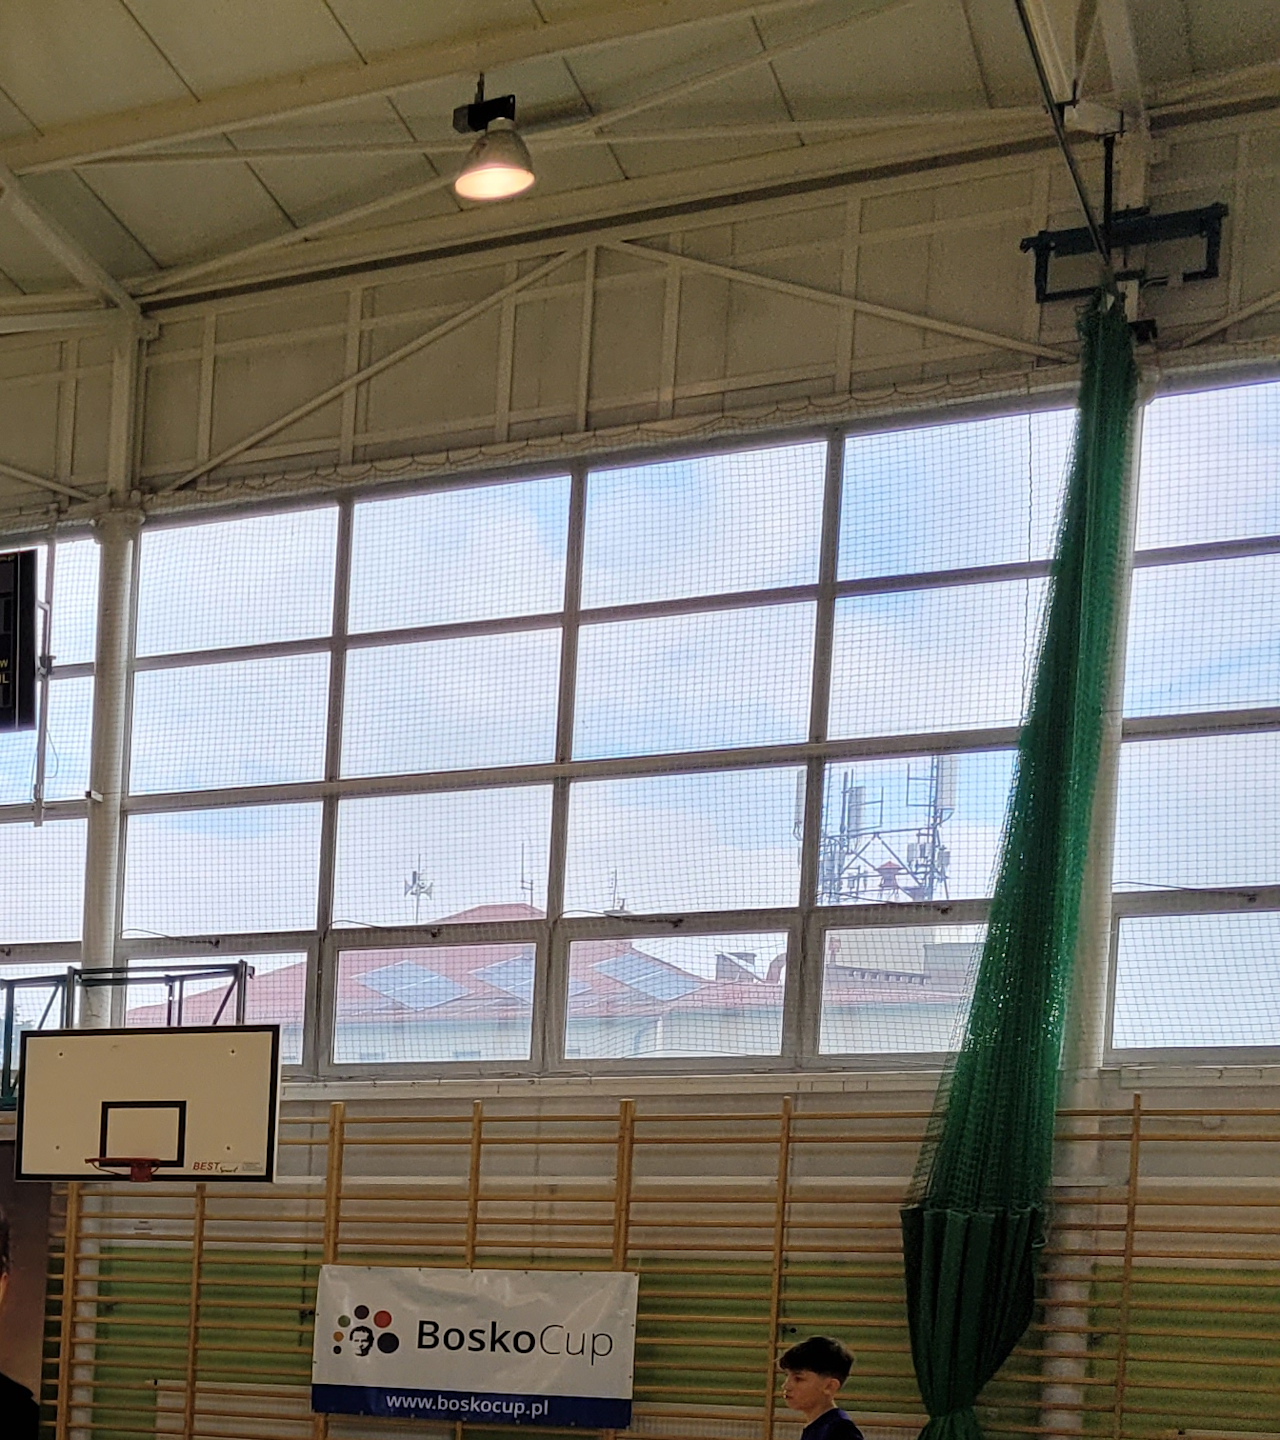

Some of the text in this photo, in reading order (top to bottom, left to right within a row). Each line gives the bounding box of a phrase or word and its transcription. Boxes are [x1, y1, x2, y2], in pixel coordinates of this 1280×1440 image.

[193, 1161, 221, 1171] BEST
[416, 1319, 614, 1366] BoskoCup
[385, 1394, 549, 1419] www.boskocup.pl
